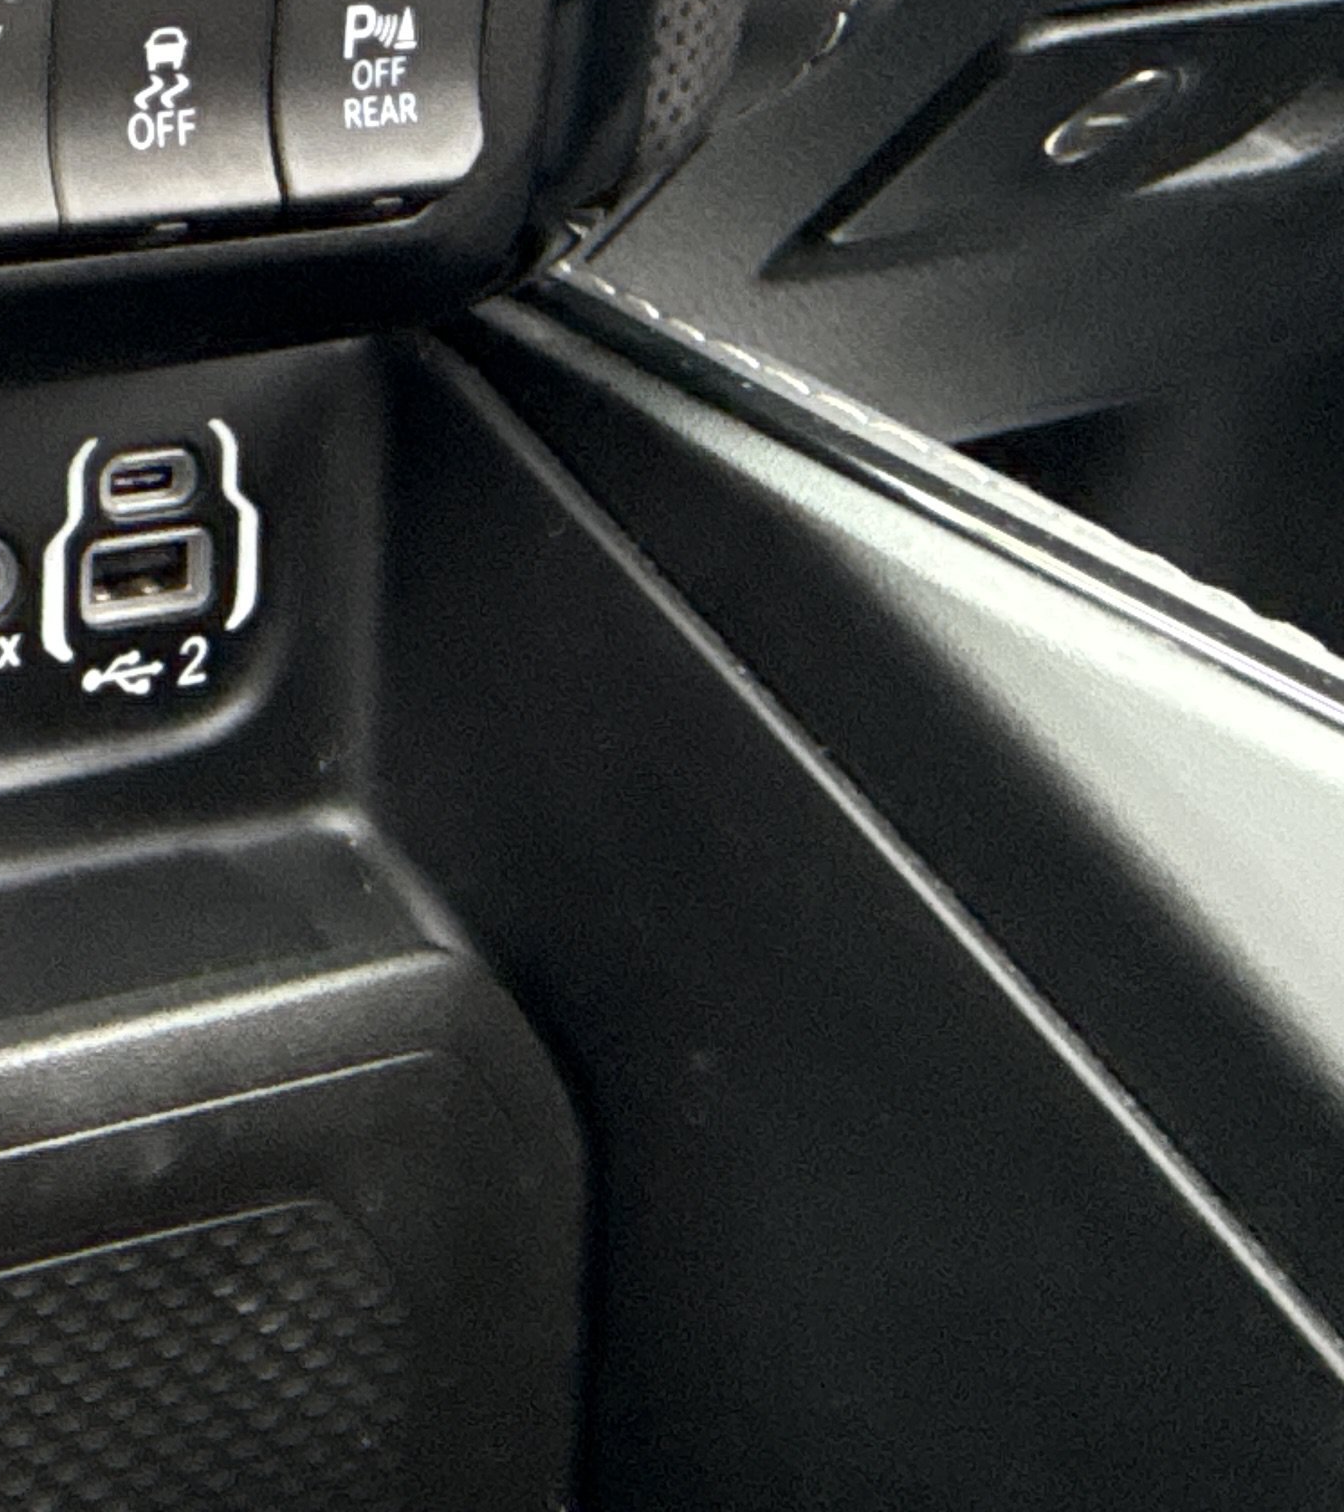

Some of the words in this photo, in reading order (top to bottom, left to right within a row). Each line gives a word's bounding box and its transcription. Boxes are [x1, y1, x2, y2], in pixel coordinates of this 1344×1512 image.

[351, 58, 408, 91] OFF
[127, 107, 197, 150] OFF
[343, 95, 419, 128] REAR
[177, 636, 209, 687] 2
